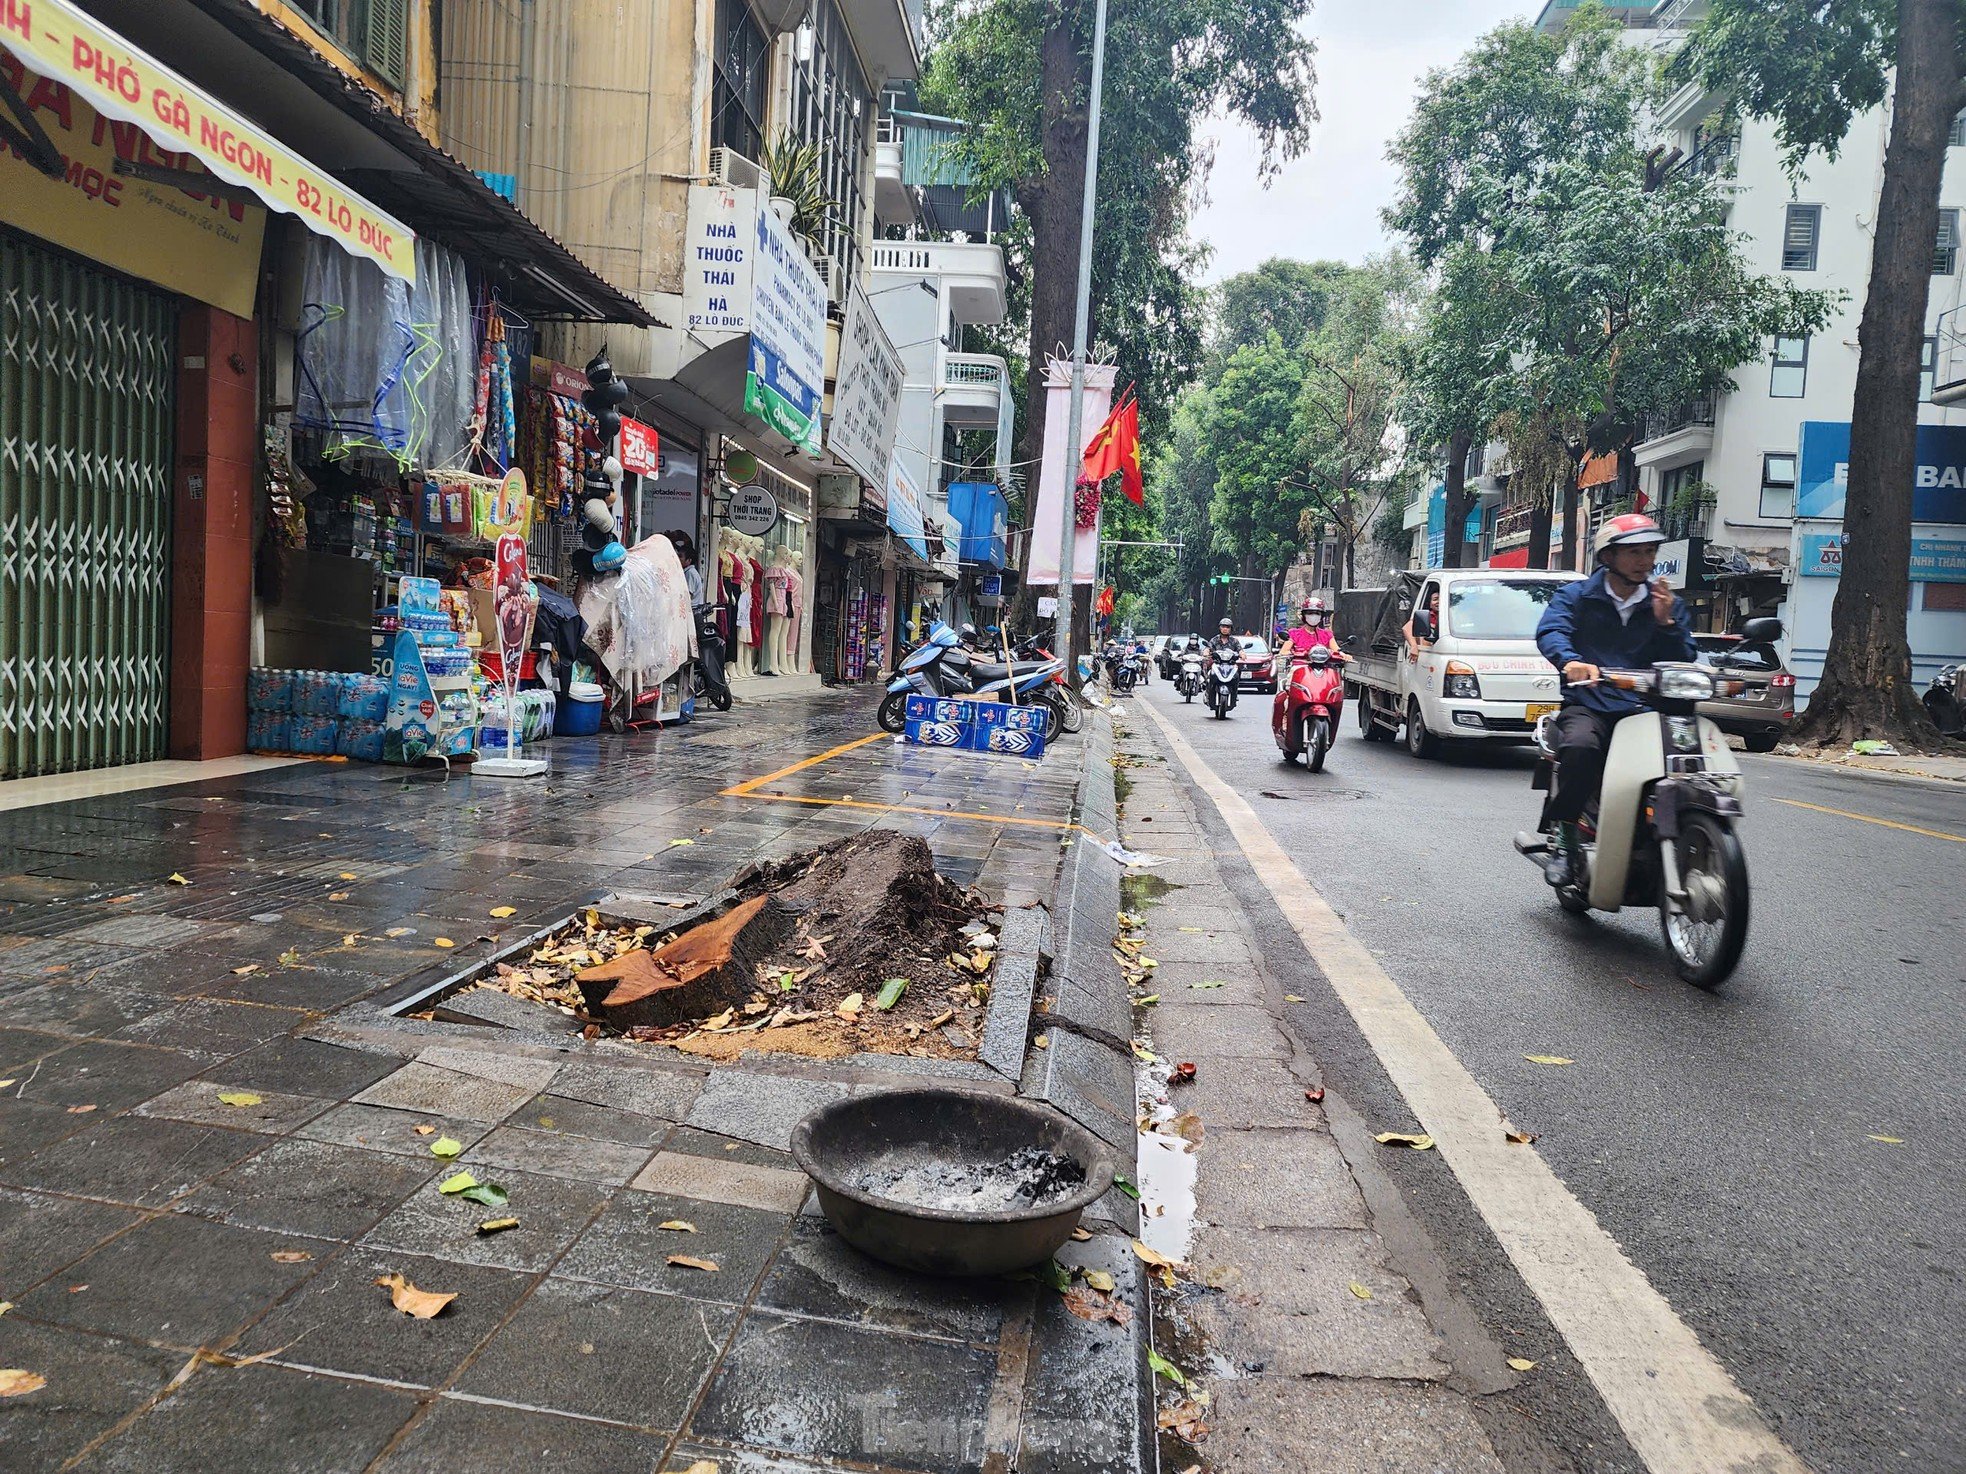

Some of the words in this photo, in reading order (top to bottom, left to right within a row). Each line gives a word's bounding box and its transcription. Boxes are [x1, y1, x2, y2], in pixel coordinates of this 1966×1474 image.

[0, 0, 31, 41] H
[152, 88, 192, 137] GÀ
[200, 118, 274, 187] NGON
[296, 178, 322, 217] 82
[327, 197, 352, 233] LÒ
[706, 222, 736, 238] NHÀ
[696, 244, 743, 263] THUỐC
[769, 227, 784, 269] NHÀ
[703, 268, 735, 285] THÁI
[708, 294, 728, 311] HÀ
[689, 314, 702, 325] 82
[705, 312, 718, 325] LÒ
[1916, 465, 1966, 489] BA
[743, 494, 762, 504] SHOP
[733, 503, 749, 514] THỜI
[751, 505, 772, 516] TRANG
[372, 656, 394, 677] 50
